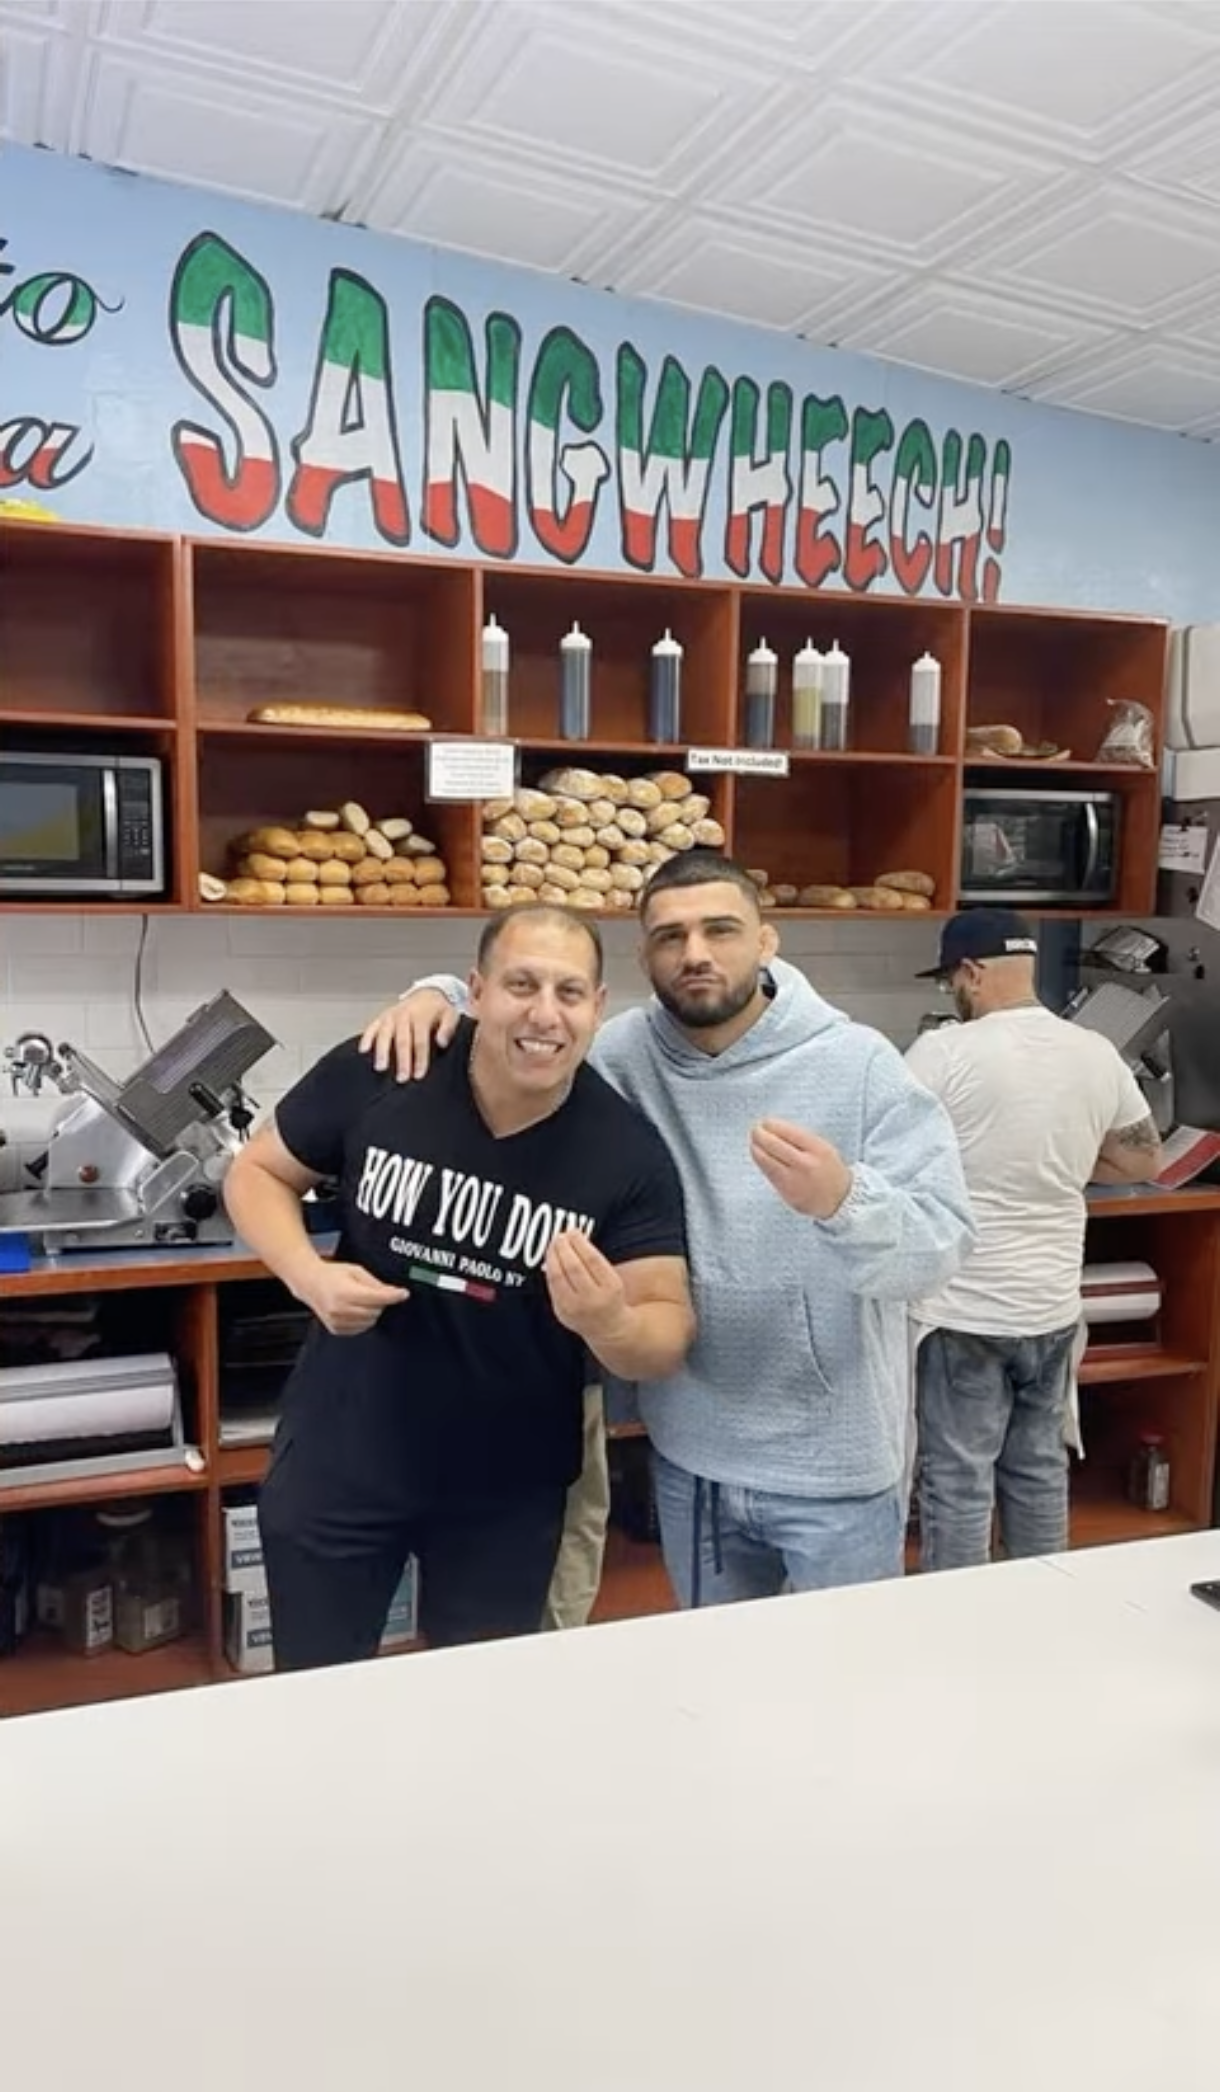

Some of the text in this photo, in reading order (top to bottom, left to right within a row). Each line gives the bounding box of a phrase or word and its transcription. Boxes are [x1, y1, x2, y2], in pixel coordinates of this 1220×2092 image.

[169, 230, 1012, 604] SANGWHEECH!
[691, 753, 709, 765] Tax
[711, 754, 733, 766] Not
[356, 1146, 433, 1227] HOW
[432, 1168, 503, 1248] YOU
[390, 1236, 526, 1288] GIOVANNI PAOLO NY
